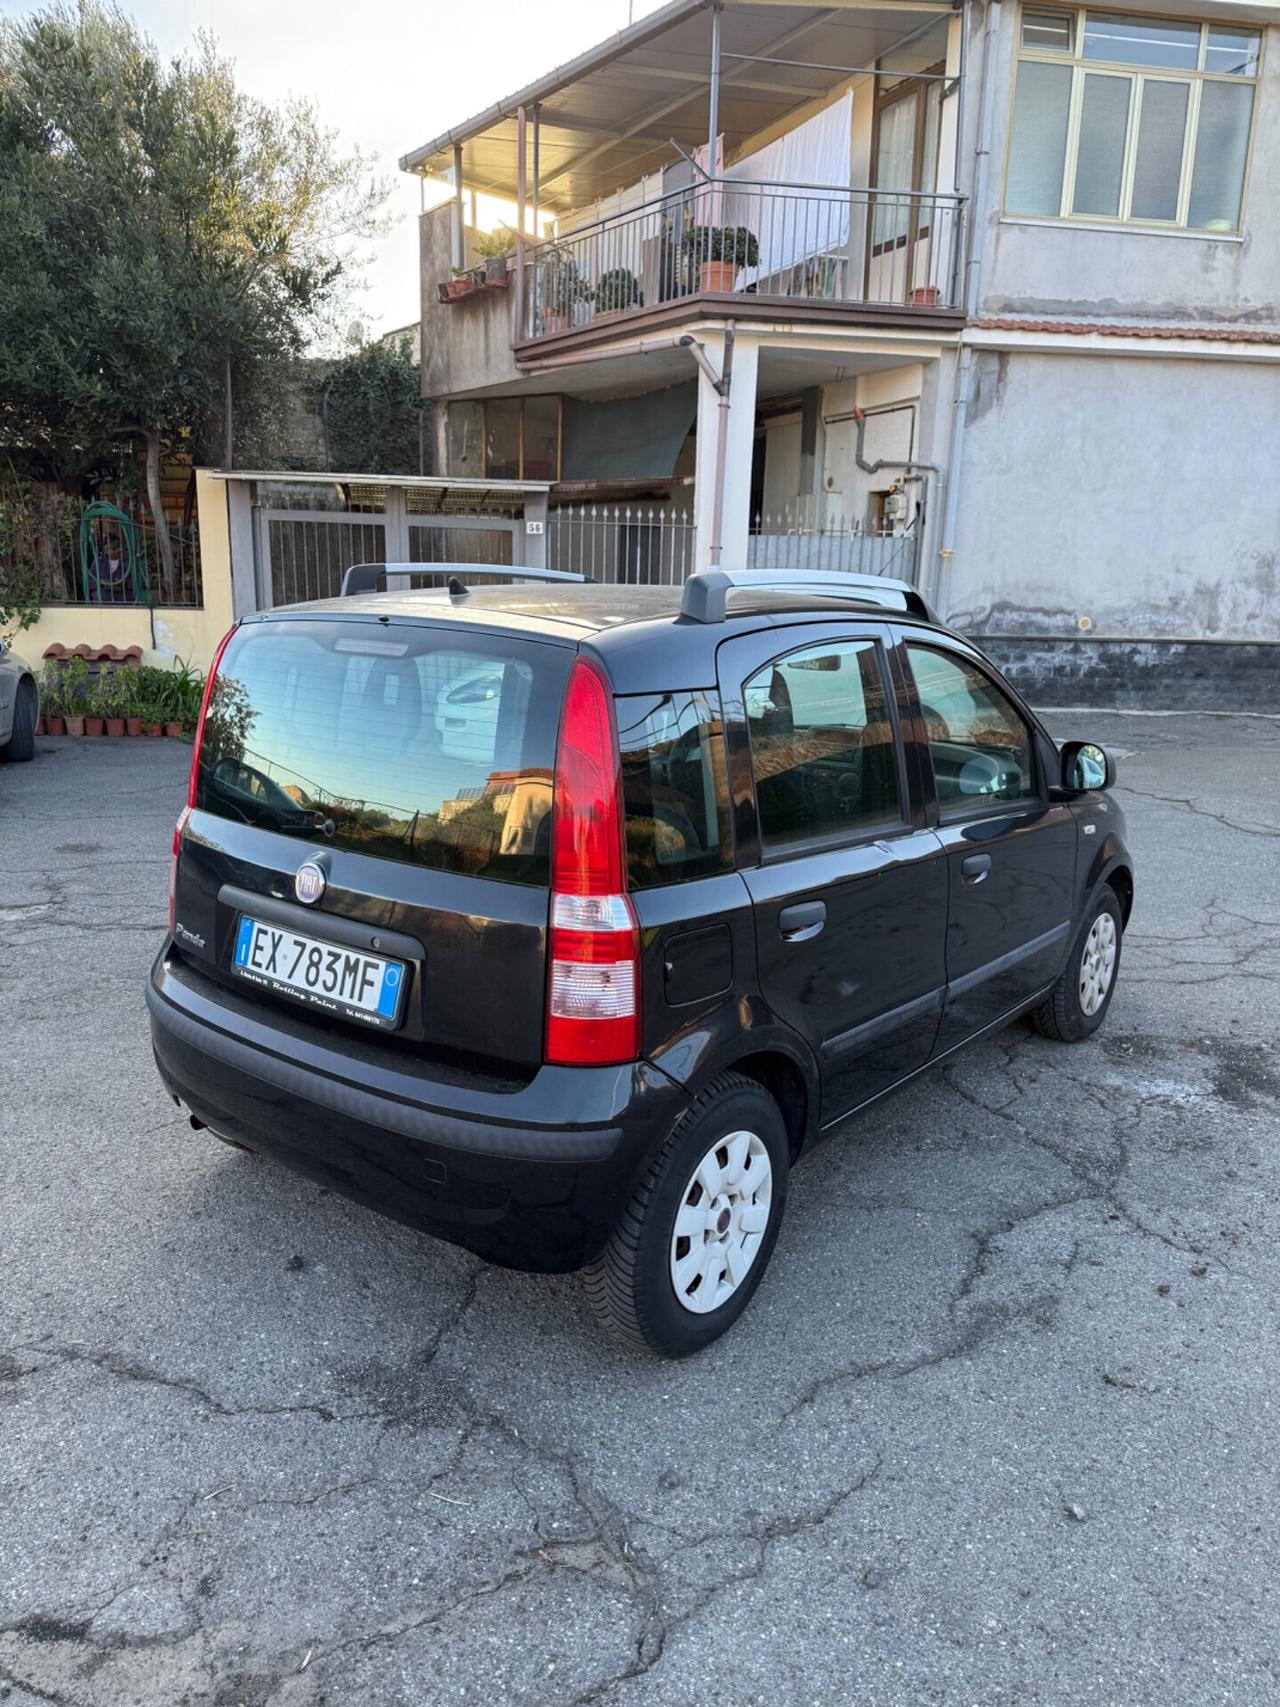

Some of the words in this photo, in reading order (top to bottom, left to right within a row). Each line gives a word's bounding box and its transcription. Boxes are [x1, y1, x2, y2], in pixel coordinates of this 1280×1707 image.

[529, 523, 541, 533] 56
[251, 927, 284, 974] EX
[287, 939, 380, 1003] 783MF
